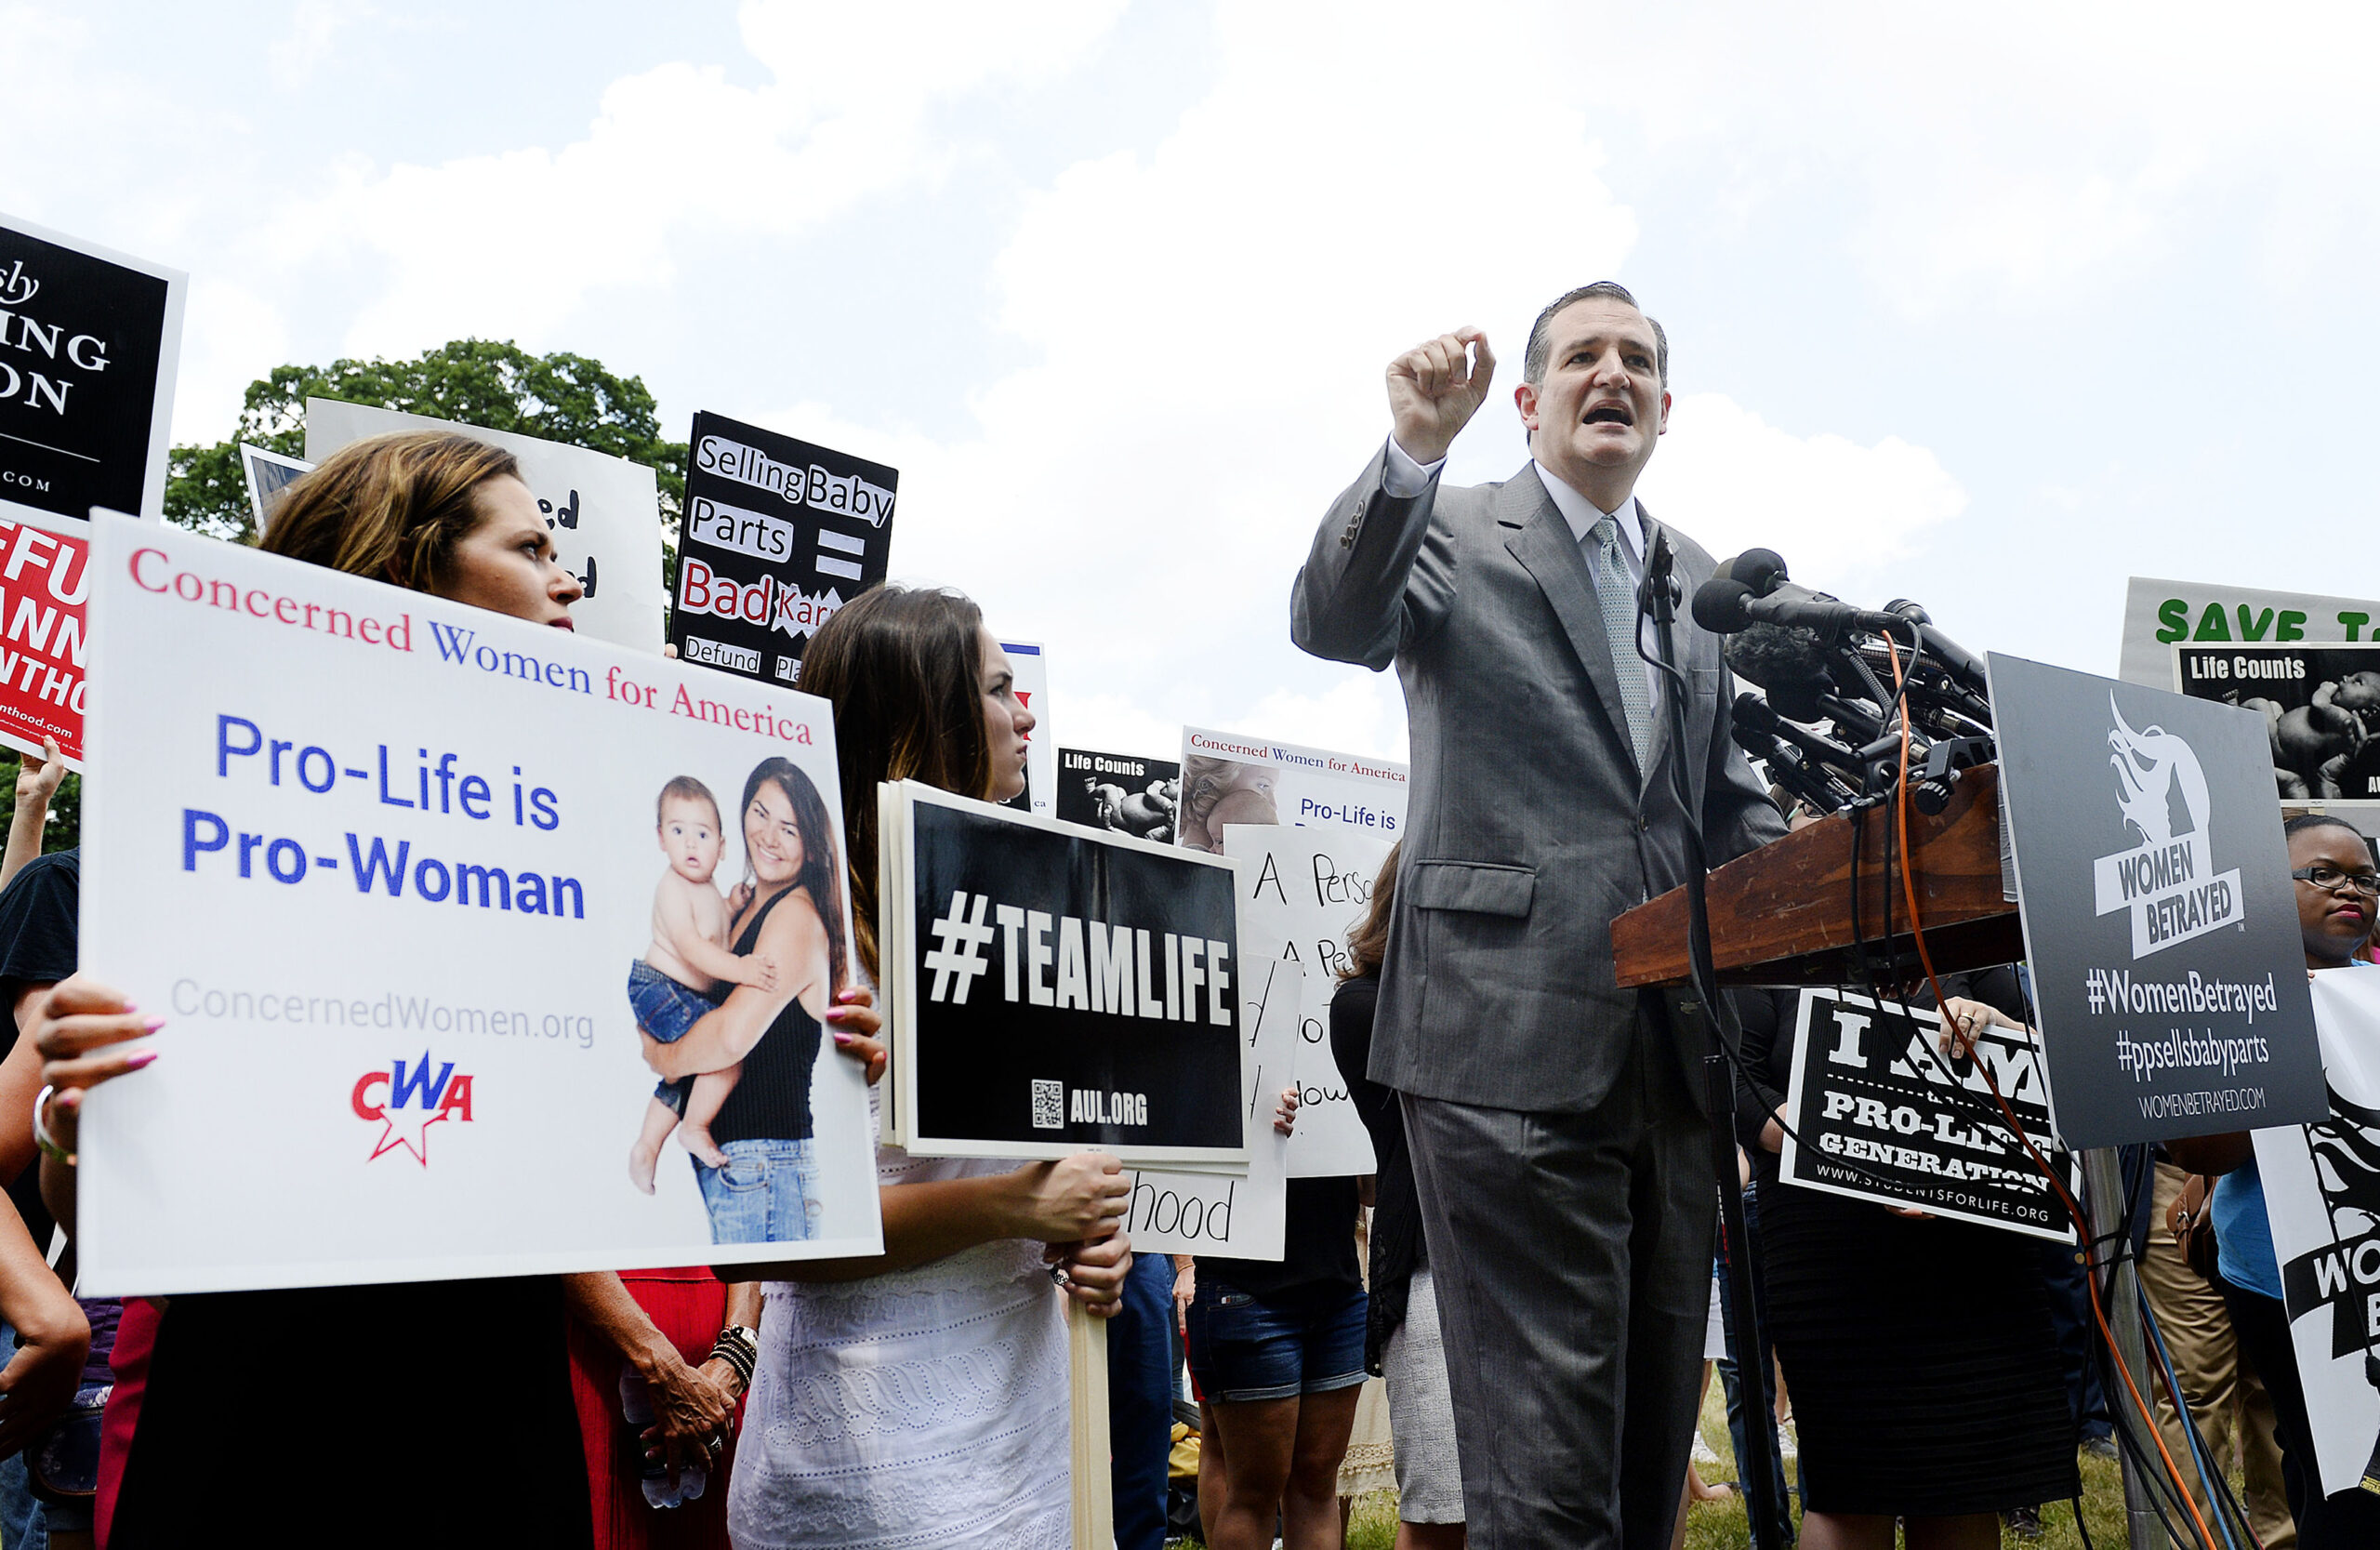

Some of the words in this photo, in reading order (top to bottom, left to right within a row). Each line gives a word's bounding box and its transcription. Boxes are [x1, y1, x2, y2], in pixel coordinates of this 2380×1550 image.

[692, 497, 787, 555] Parts
[683, 562, 772, 623] Bad
[778, 590, 836, 627] Kar
[2155, 598, 2307, 643] SAVE
[0, 586, 90, 669] NN
[127, 547, 415, 653] Concerned
[427, 619, 593, 696] Women
[605, 666, 658, 709] for
[669, 682, 813, 746] America
[686, 638, 760, 672] Defund
[2190, 656, 2229, 680] Life
[2233, 656, 2306, 680] Counts
[217, 712, 492, 820] Pro-Life
[512, 766, 560, 831] is
[1064, 752, 1092, 771] Life
[1094, 756, 1145, 777] Counts
[1191, 734, 1268, 759] Concerned
[1272, 747, 1324, 768] Women
[1329, 758, 1347, 772] for
[1350, 762, 1406, 782] America
[1301, 798, 1375, 827] Pro-Life
[1382, 811, 1396, 830] is
[180, 807, 586, 920] Pro-Woman
[1253, 852, 1288, 906] A
[2118, 840, 2194, 901] WOMEN
[2146, 880, 2232, 945] BETRAYED
[924, 890, 1232, 1027] #TEAMLIFE
[170, 977, 595, 1049] ConcernedWomen.org
[2085, 968, 2278, 1025] #WomenBetrayed
[350, 1048, 474, 1121] CWA
[1829, 1009, 1871, 1068] I
[1890, 1027, 2048, 1106] AM
[2116, 1027, 2269, 1083] #ppsellsbabyparts
[1070, 1089, 1148, 1127] AUL.ORG
[1822, 1090, 2053, 1163] PRO-LIFE
[2137, 1086, 2267, 1119] WOMENBETRAYED.COM
[1818, 1132, 2050, 1196] GENERATION
[1127, 1171, 1235, 1243] hood
